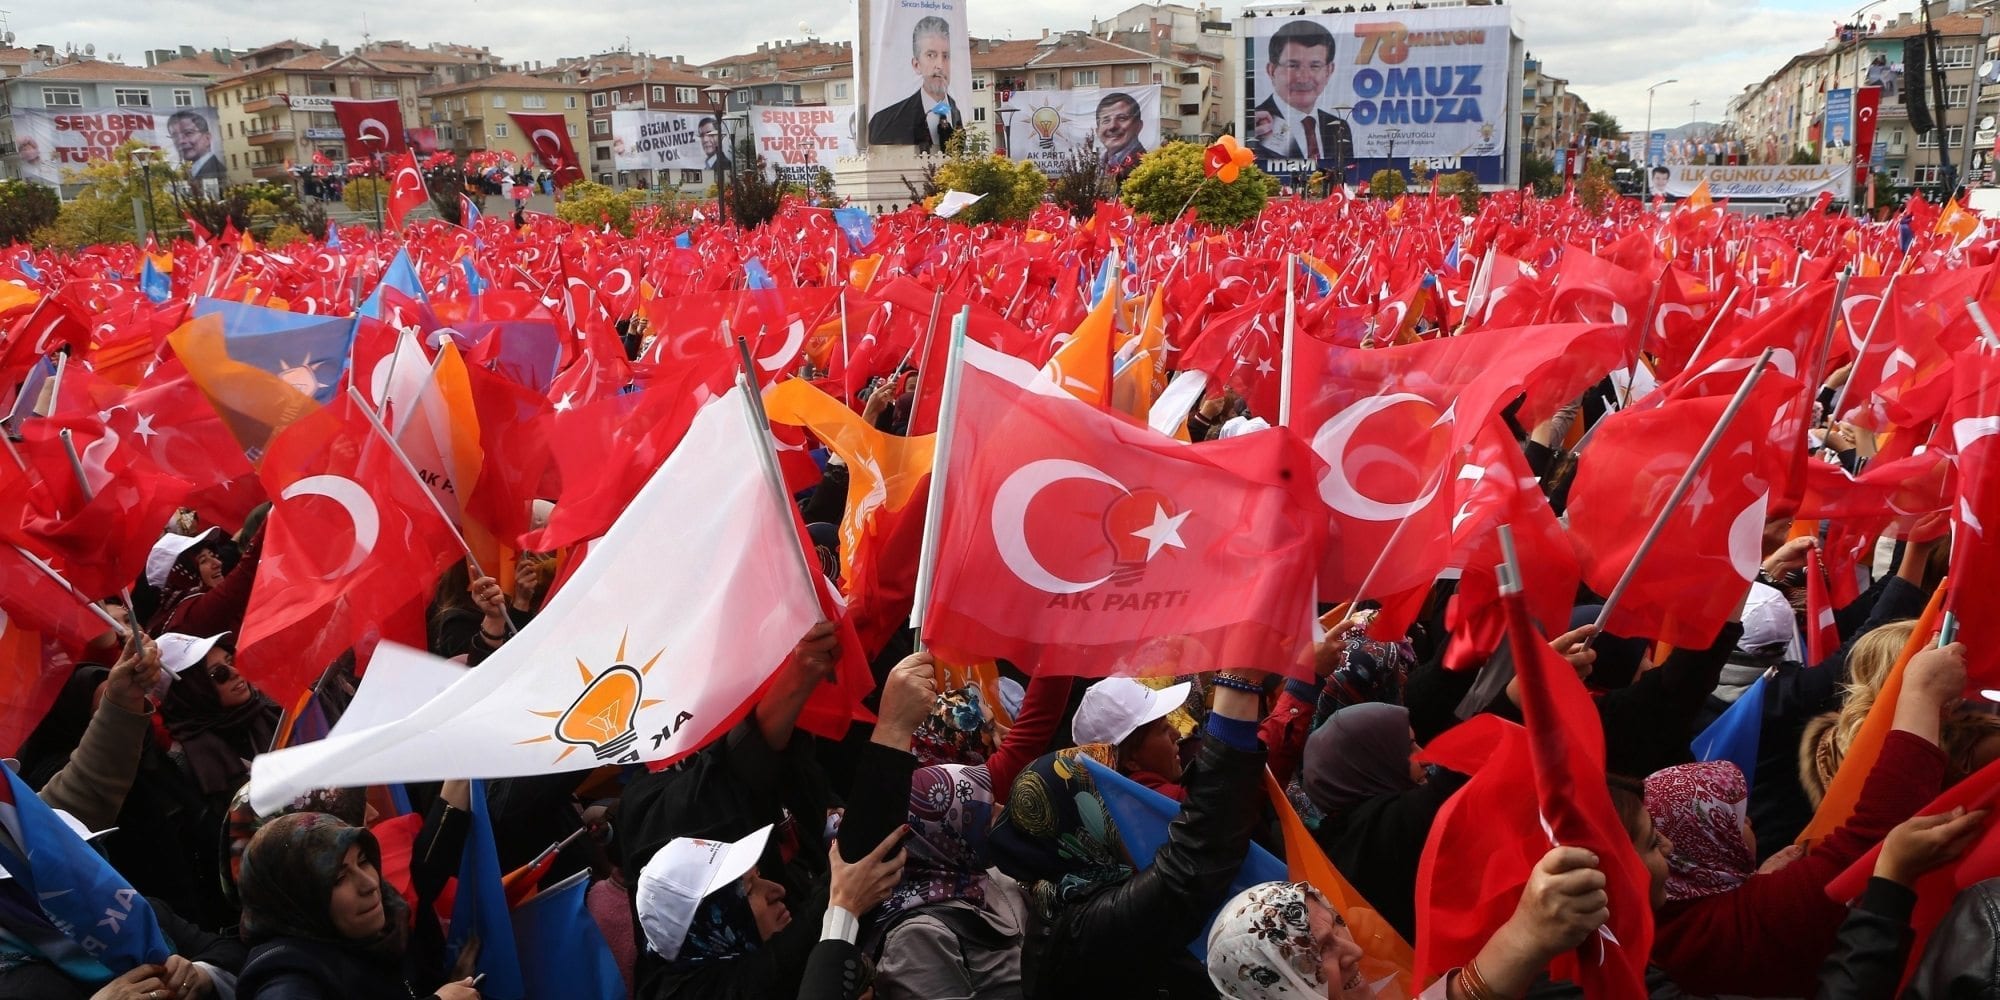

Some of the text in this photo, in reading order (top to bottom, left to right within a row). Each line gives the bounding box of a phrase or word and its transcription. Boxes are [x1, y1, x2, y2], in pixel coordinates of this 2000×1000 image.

[1354, 22, 1486, 64] 78 MİLYON
[1352, 65, 1483, 99] OMUZ
[761, 110, 834, 124] SEN BEN
[1352, 97, 1483, 125] OMUZA
[54, 114, 155, 131] SEN BEN
[640, 118, 687, 138] BİZİM DE
[779, 124, 817, 137] YOK
[80, 131, 134, 147] YOK
[636, 131, 696, 154] KORKUMUZ
[761, 136, 838, 151] TÜRKİYE
[658, 148, 680, 163] YOK
[781, 150, 818, 165] VAR
[1027, 151, 1039, 160] AK
[1033, 160, 1065, 169] NKARA
[1267, 158, 1316, 172] mavi
[1680, 167, 1831, 183] İLK GÜNKÜ AŞKLA
[419, 469, 440, 487] AK
[1046, 589, 1191, 612] AK PARTİ
